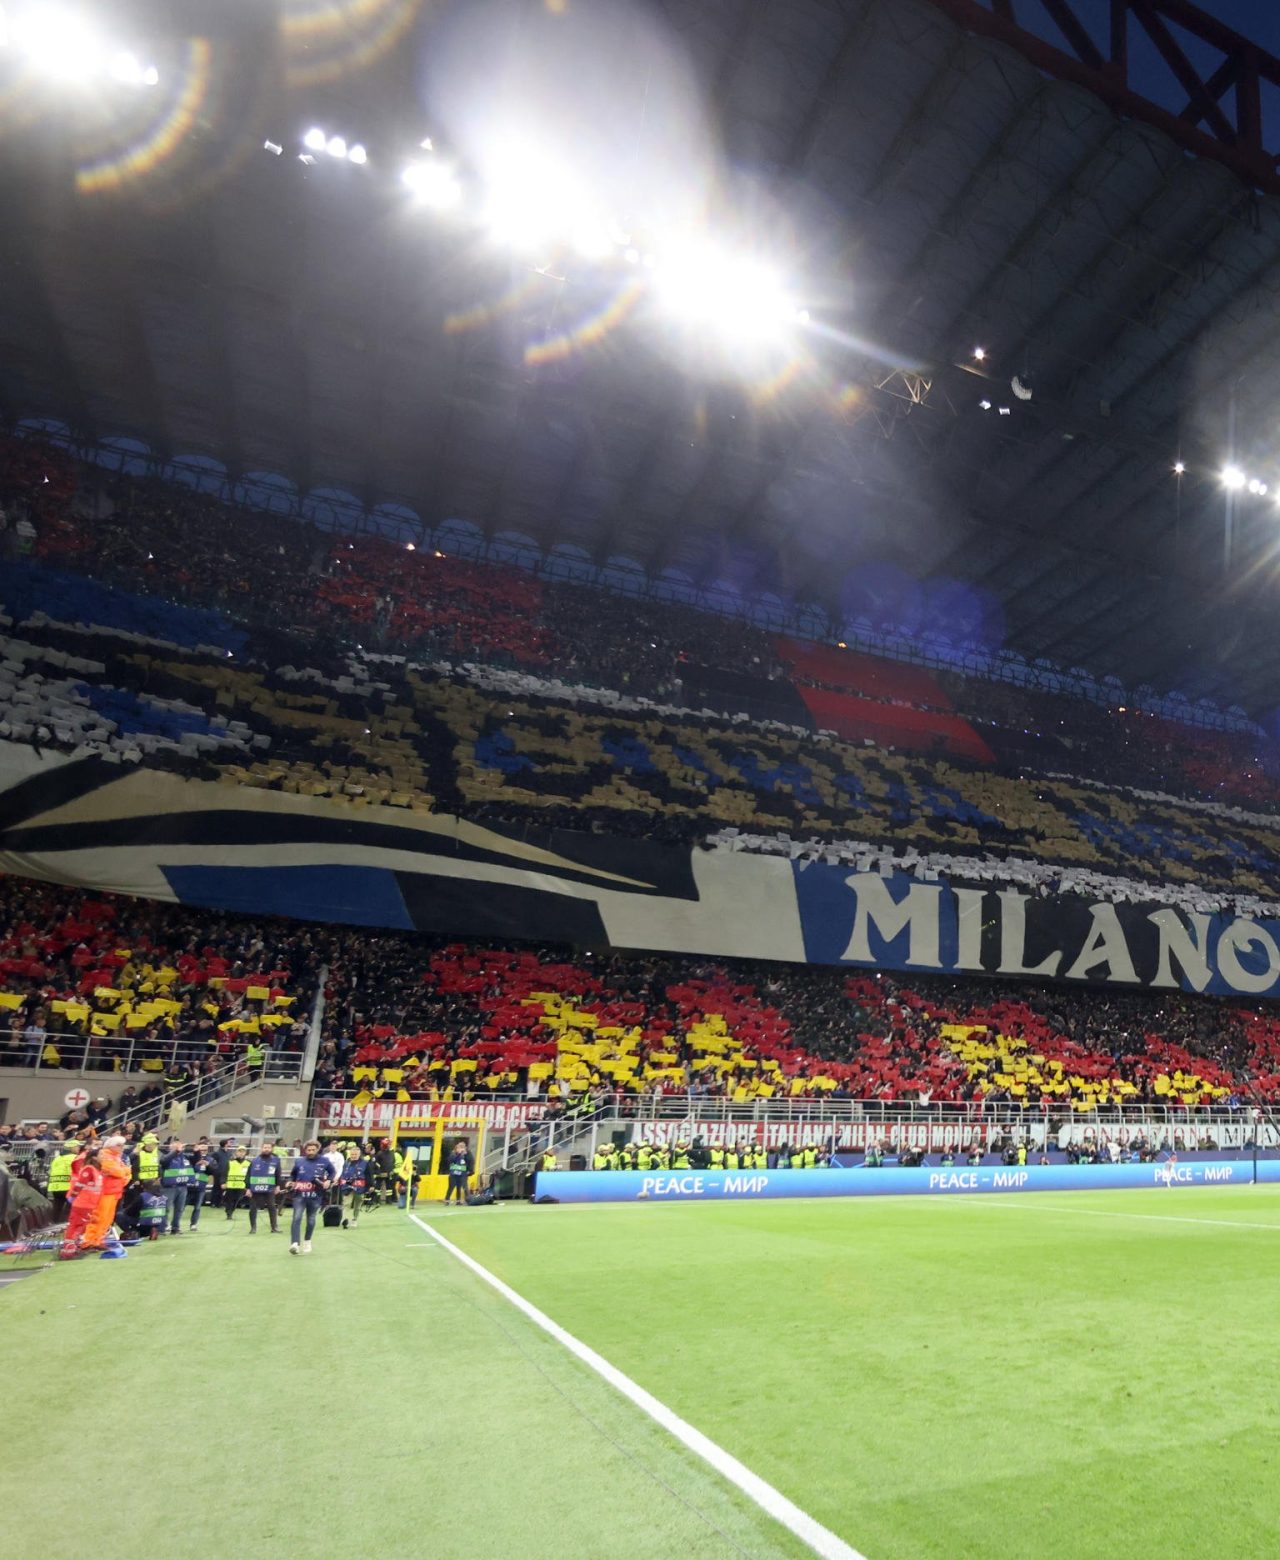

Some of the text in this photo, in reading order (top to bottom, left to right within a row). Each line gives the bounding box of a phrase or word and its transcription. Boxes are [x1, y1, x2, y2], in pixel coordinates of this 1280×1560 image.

[841, 873, 1280, 993] MILANO
[328, 1102, 374, 1127] CASA
[379, 1103, 432, 1128] MILAN
[447, 1104, 506, 1129] JUNIOR
[631, 1122, 758, 1148] ASSOCIAZIONE
[839, 1124, 886, 1147] MILAN
[890, 1125, 927, 1148] CLUB
[932, 1125, 981, 1147] MONDO
[641, 1177, 704, 1193] PEACE
[724, 1176, 768, 1192] МИР
[930, 1173, 978, 1188] PEACE
[993, 1172, 1028, 1186] МИР
